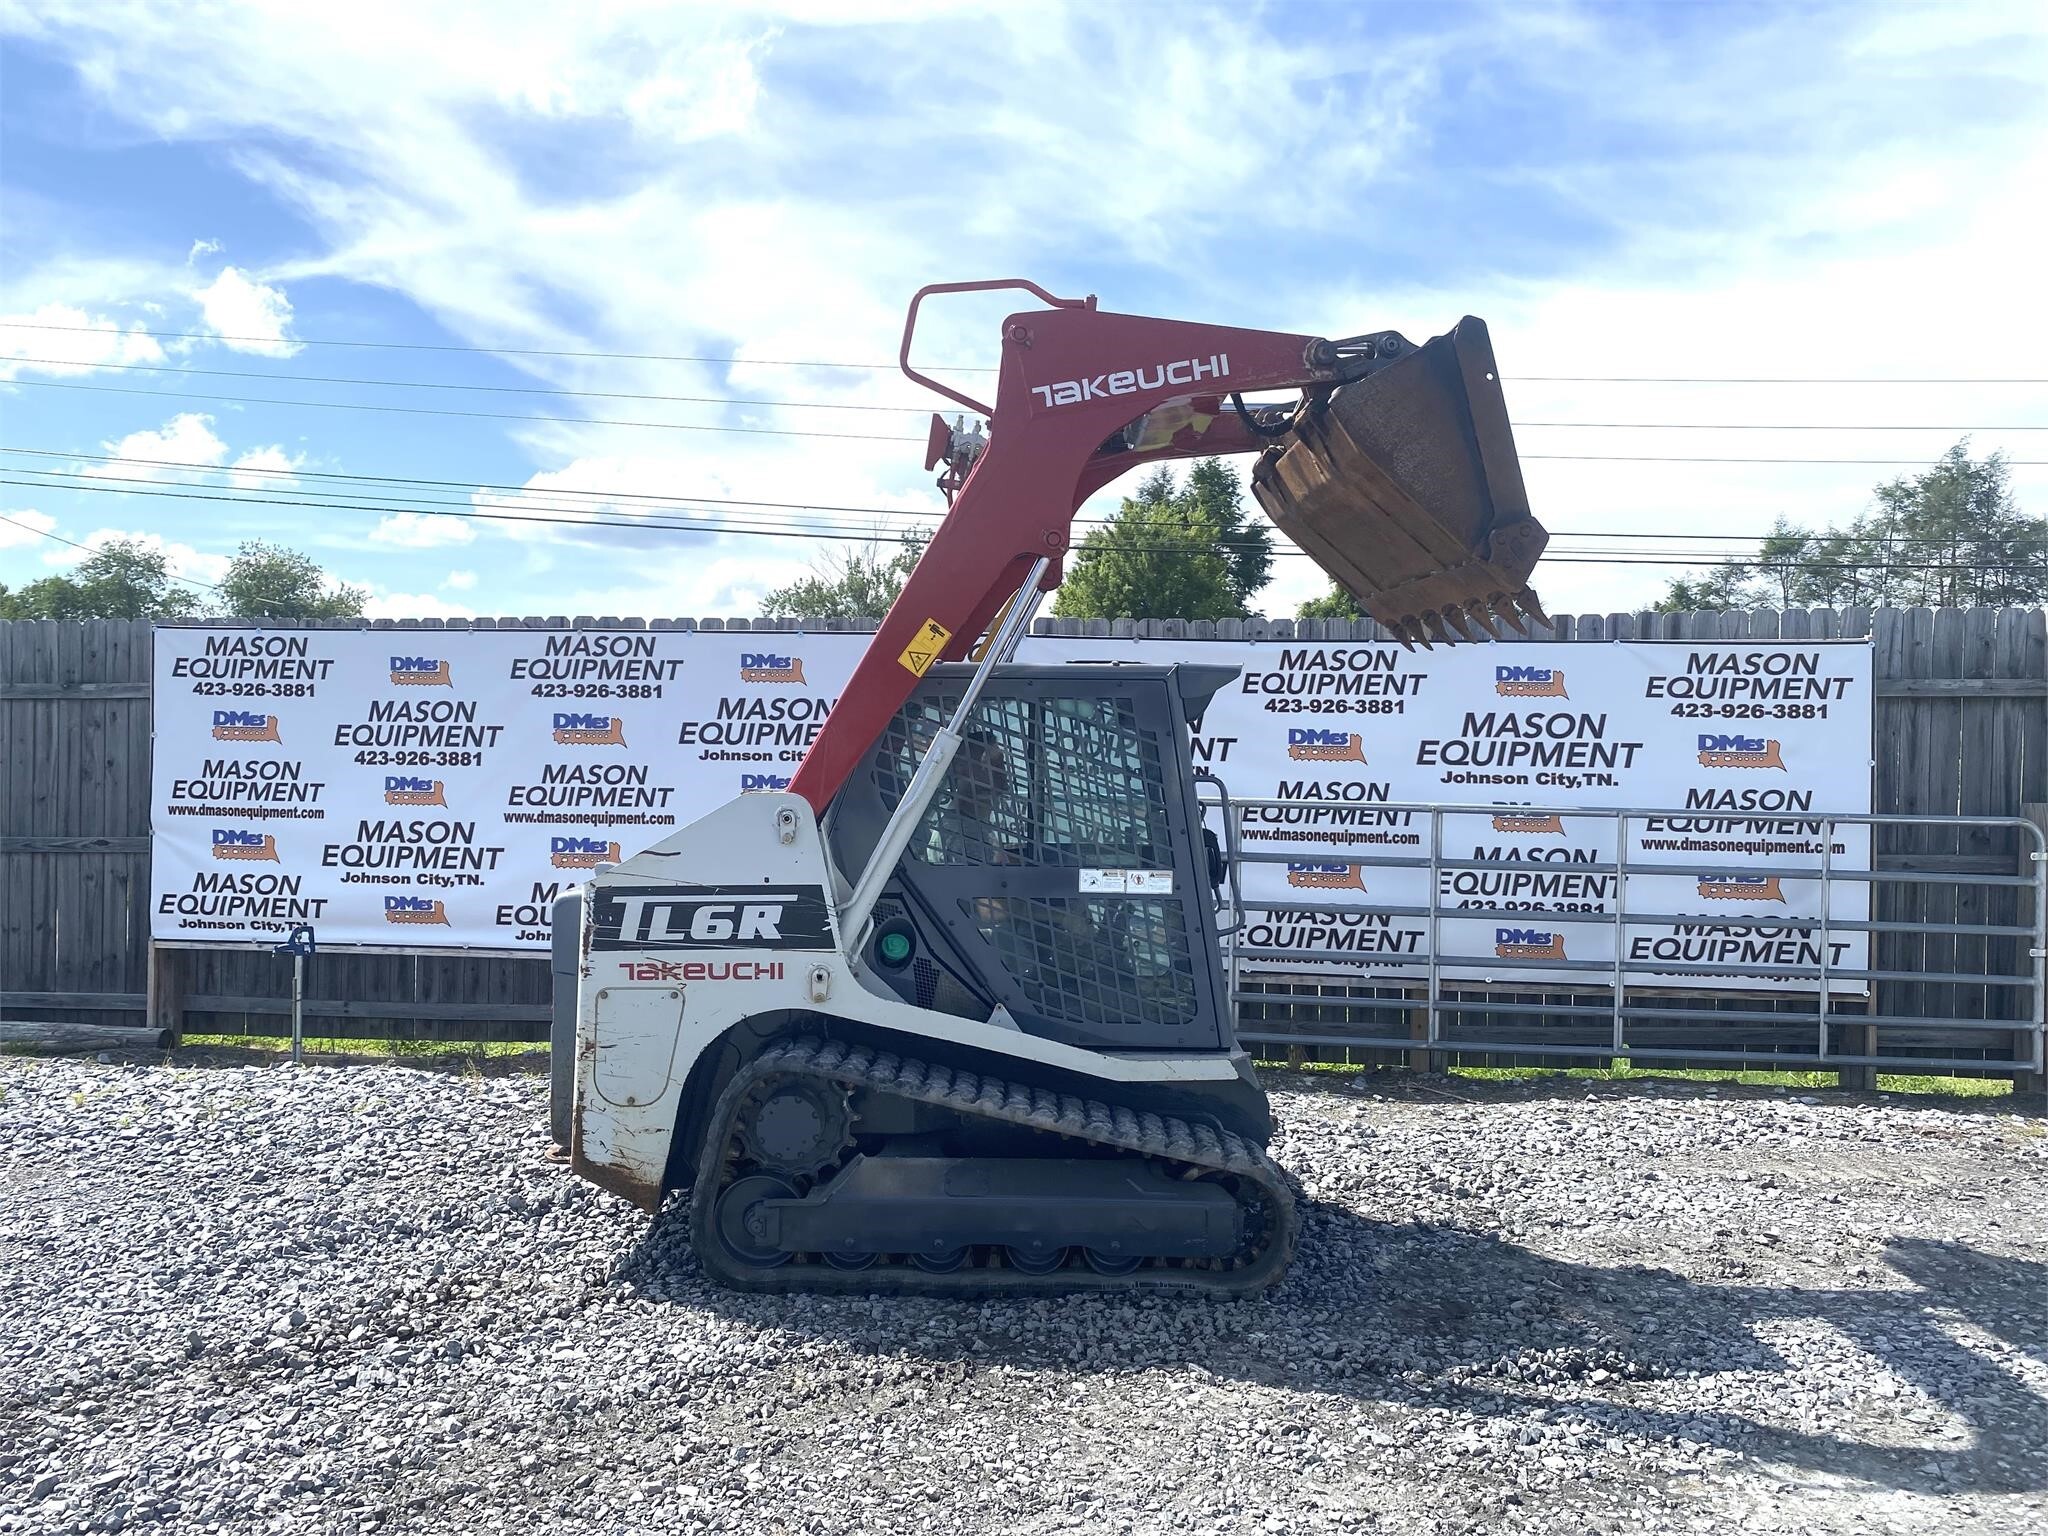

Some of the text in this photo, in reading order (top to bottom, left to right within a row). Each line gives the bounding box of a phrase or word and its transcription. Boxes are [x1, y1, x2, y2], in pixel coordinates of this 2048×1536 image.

[204, 636, 308, 657] MASON
[545, 636, 656, 657] MASON
[171, 658, 334, 681] EQUIPMENT
[510, 659, 684, 681] EQUIPMENT
[1278, 649, 1399, 672] MASON
[1686, 653, 1820, 676] MASON
[192, 682, 315, 698] 423-926-3881
[531, 683, 662, 699] 423-926-3881
[1242, 673, 1427, 696] EQUIPMENT
[1645, 676, 1854, 700] EQUIPMENT
[367, 701, 477, 723] MASON
[717, 698, 838, 721] MASON
[1264, 698, 1404, 714] 423-926-3881
[1671, 703, 1828, 719] 423-926-3881
[334, 725, 504, 748] EQUIPMENT
[678, 722, 824, 746] EQUIPME
[1461, 712, 1607, 739] MASON
[354, 750, 482, 766] 423-926-3881
[698, 750, 773, 761] Johnson
[1416, 740, 1643, 769] EQUIPMENT
[201, 759, 301, 780] MASON
[541, 764, 648, 785] MASON
[1440, 771, 1619, 788] Johnson City,TN.
[171, 780, 325, 802] EQUIPMENT
[508, 786, 675, 808] EQUIPMENT
[1277, 781, 1390, 802] MASON
[1685, 788, 1812, 812] MASON
[168, 804, 325, 821] www.dmasonequipment.com
[504, 810, 675, 827] www.dmasonequipment.com
[357, 820, 475, 844] MASON
[321, 844, 504, 870] EQUIPMENT
[1473, 846, 1597, 864] MASON
[1641, 837, 1846, 856] www.dmasonequipment.cm
[192, 872, 302, 895] MASON
[340, 872, 485, 888] Johnson City,TN.
[158, 894, 328, 918] EQUIPMENT
[178, 919, 245, 930] Johnson
[611, 894, 798, 941] TL6R
[1629, 937, 1851, 966] EQUIPMENT
